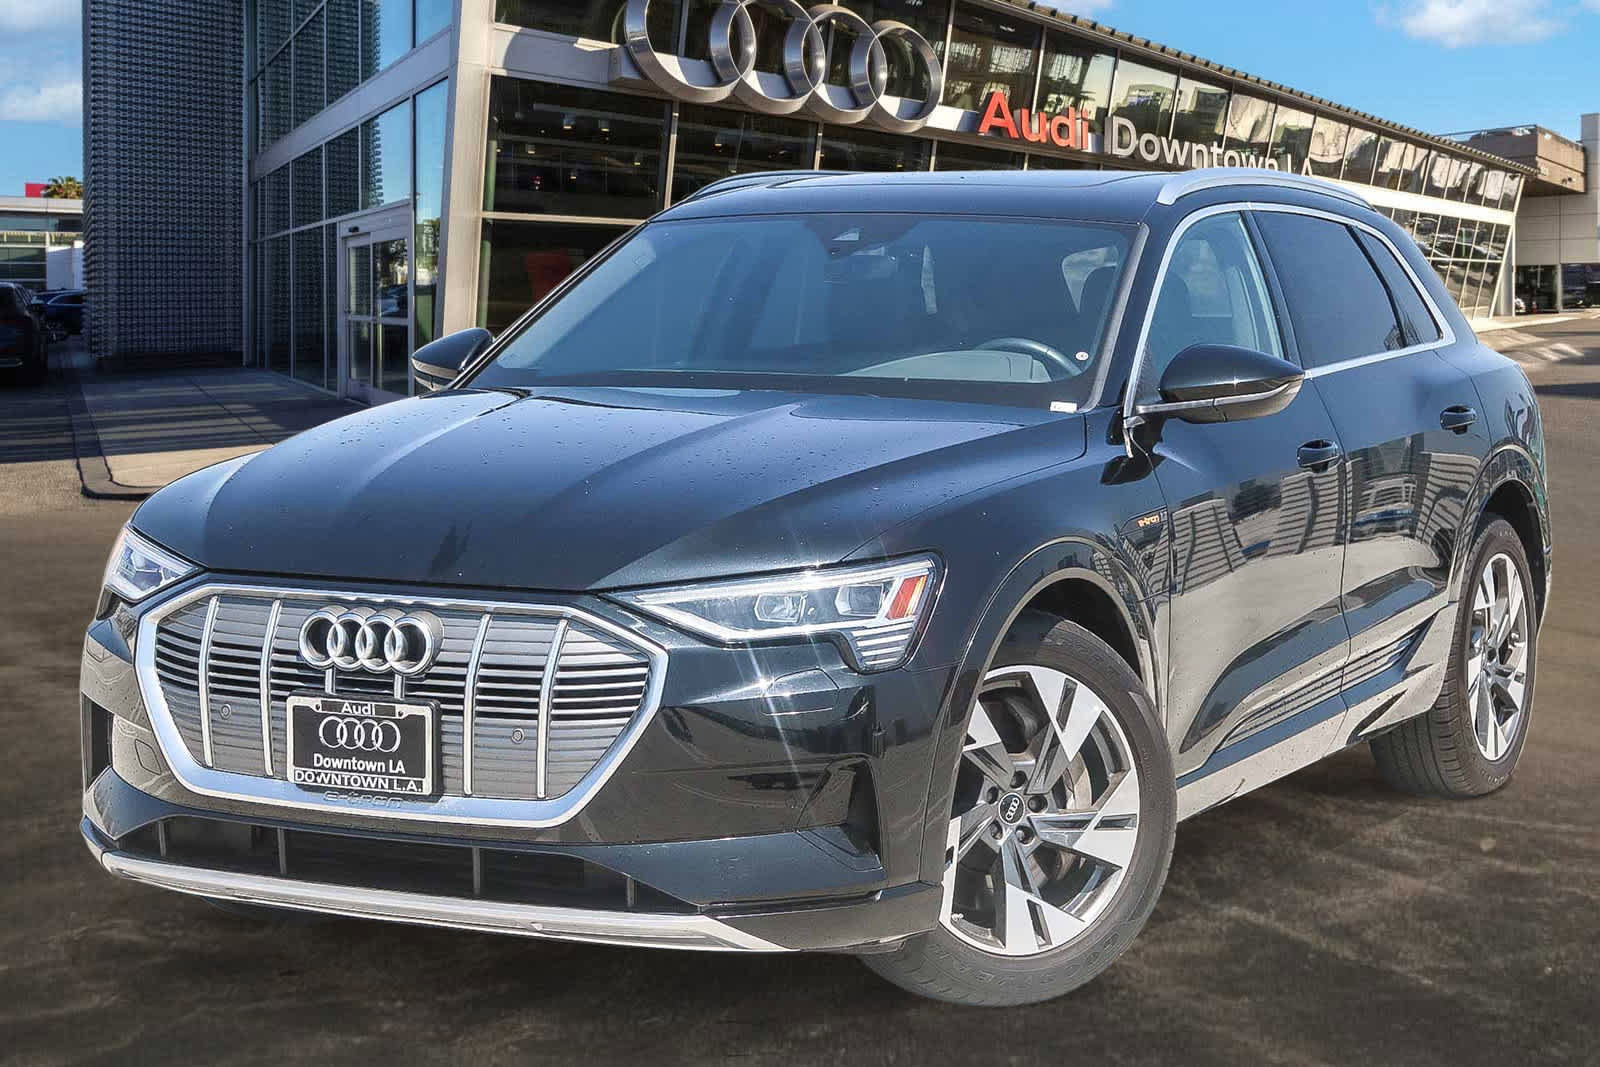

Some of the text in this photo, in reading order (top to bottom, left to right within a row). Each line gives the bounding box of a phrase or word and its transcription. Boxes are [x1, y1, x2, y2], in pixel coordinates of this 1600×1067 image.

[978, 91, 1090, 150] Audi
[1107, 116, 1278, 171] Downtown
[341, 703, 375, 716] Audi
[313, 753, 406, 774] Downtown LA
[294, 771, 423, 792] DOWNTOWN L.A.
